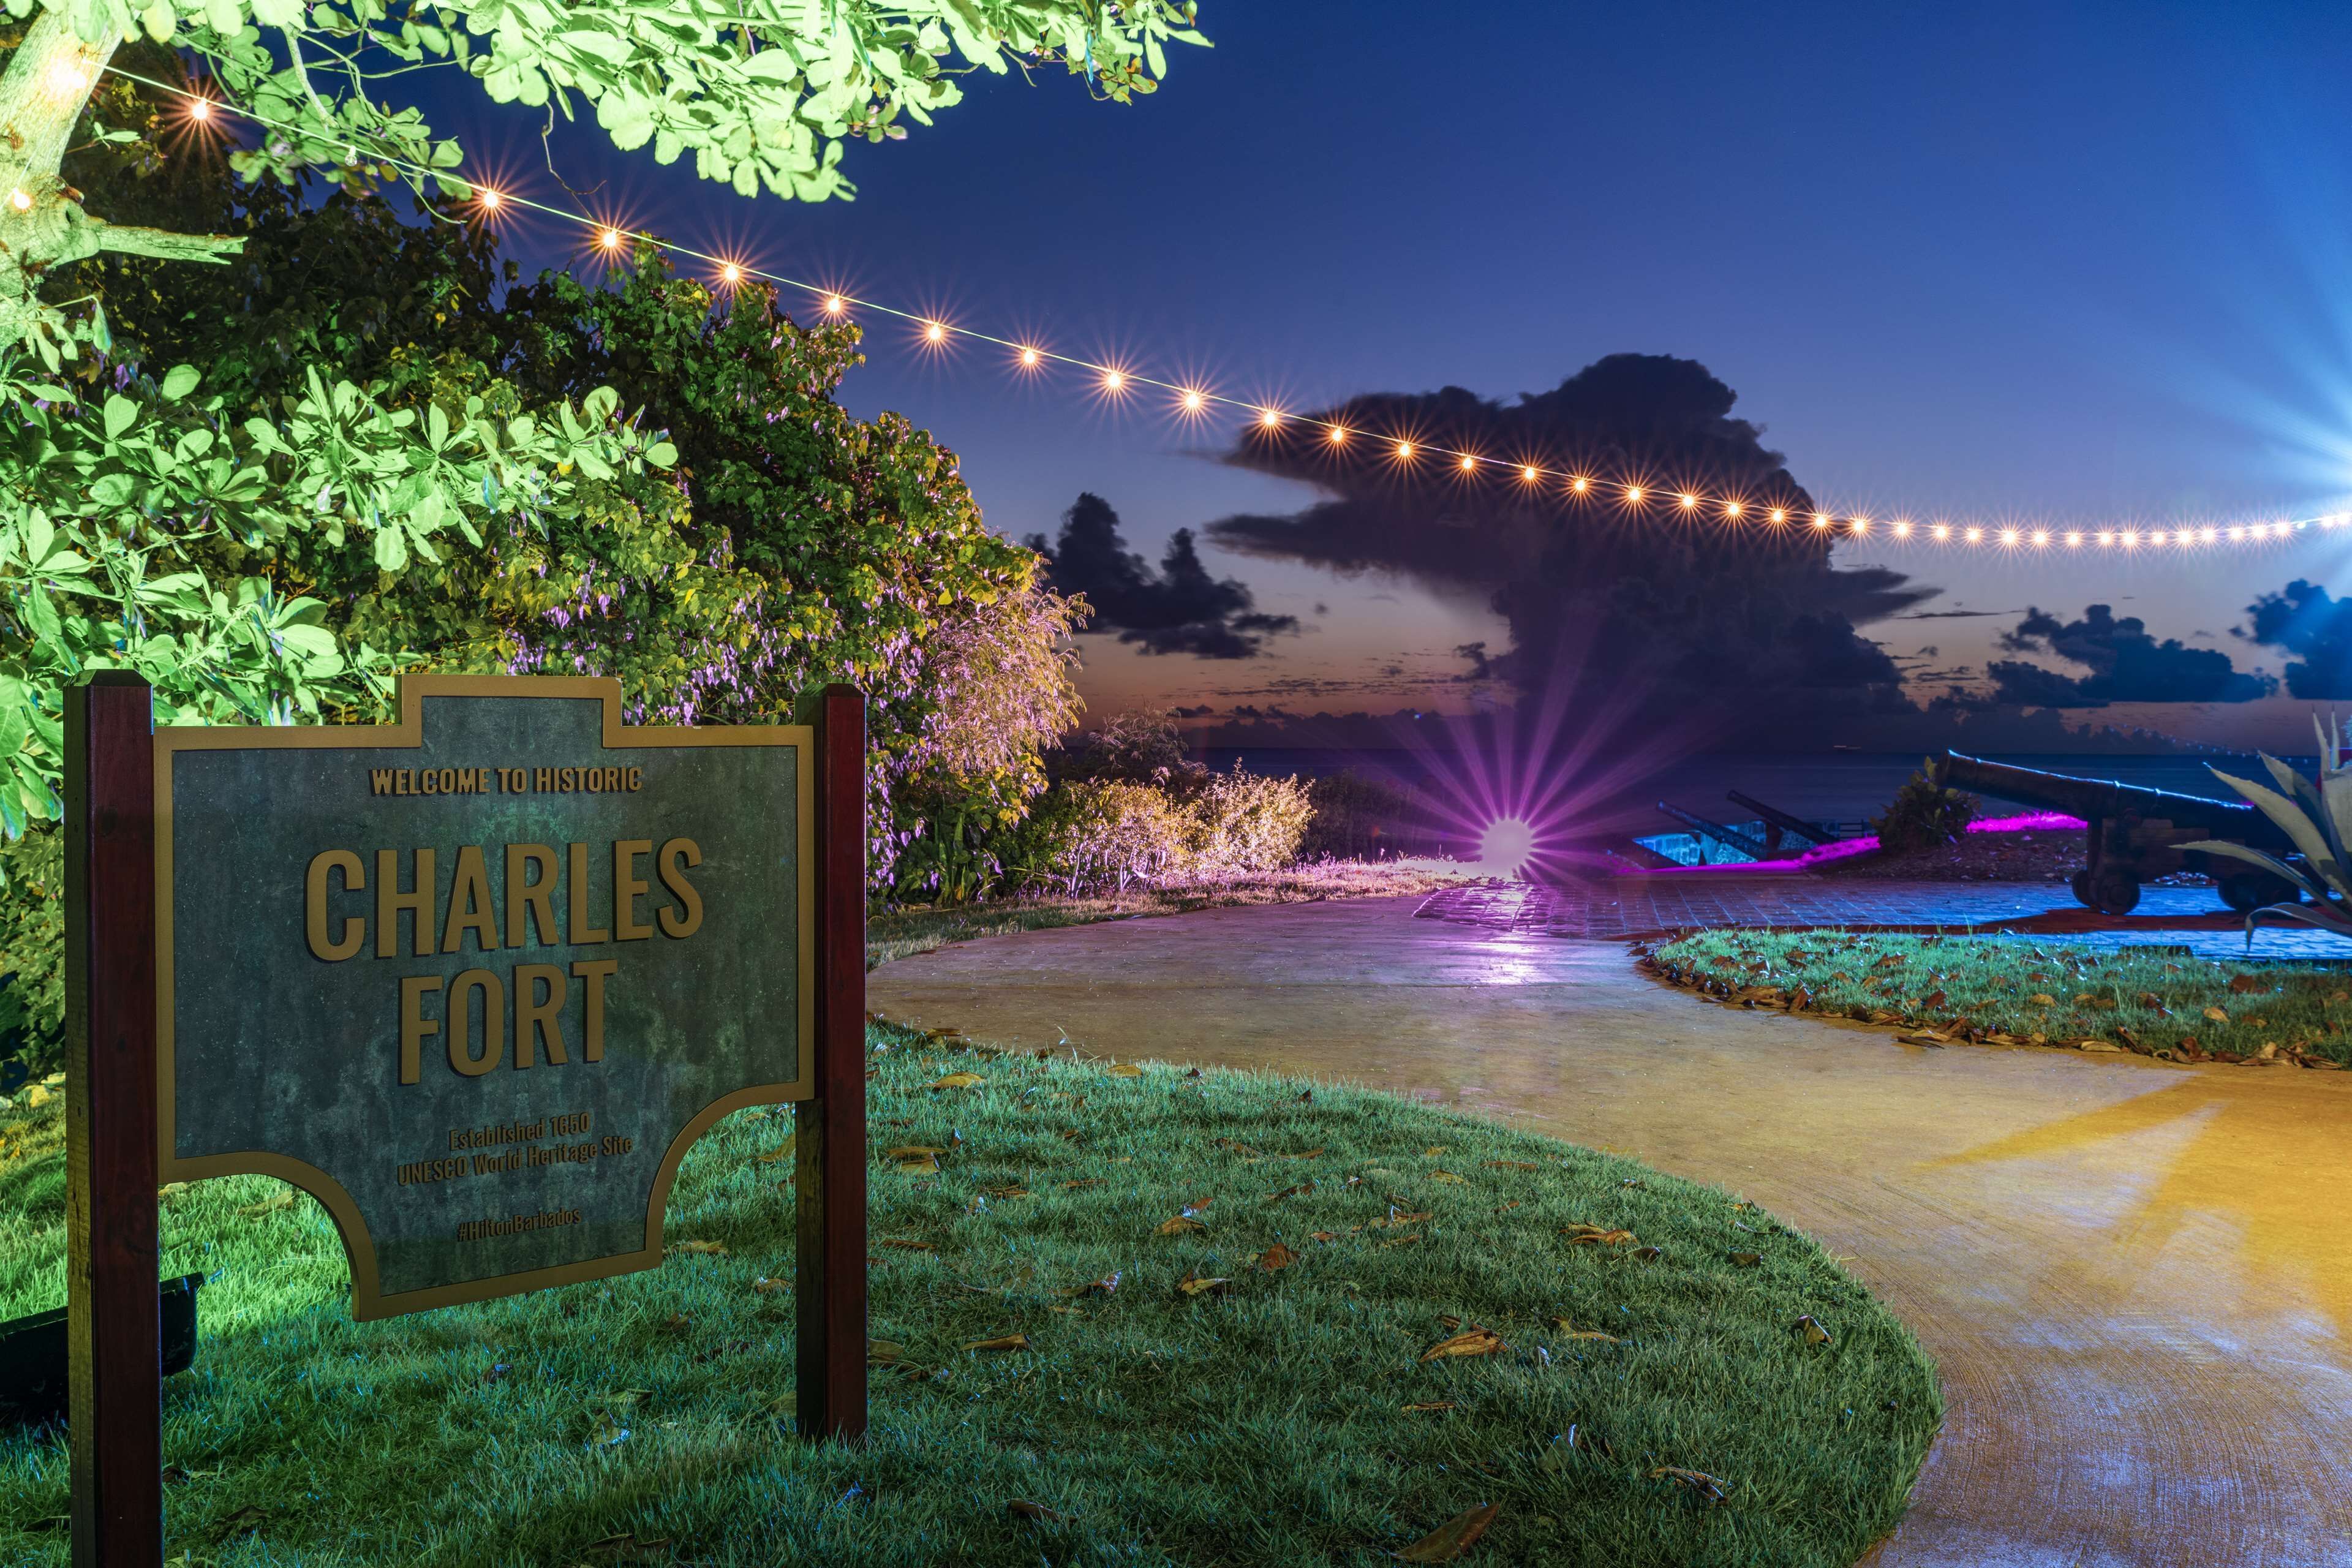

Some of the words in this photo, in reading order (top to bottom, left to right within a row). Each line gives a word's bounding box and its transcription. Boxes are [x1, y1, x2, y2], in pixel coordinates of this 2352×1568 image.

[372, 768, 490, 794] WELCOME
[498, 768, 527, 793] TO
[535, 767, 643, 792] HISTORIC
[306, 837, 703, 962] CHARLES
[401, 960, 617, 1084] FORT
[450, 1118, 546, 1150] Established
[551, 1112, 590, 1135] 1650
[398, 1157, 468, 1185] UNESCO
[475, 1150, 522, 1175] World
[528, 1143, 597, 1164] Heritage
[603, 1137, 633, 1155] Site
[459, 1208, 581, 1241] #HiltonBarbados
